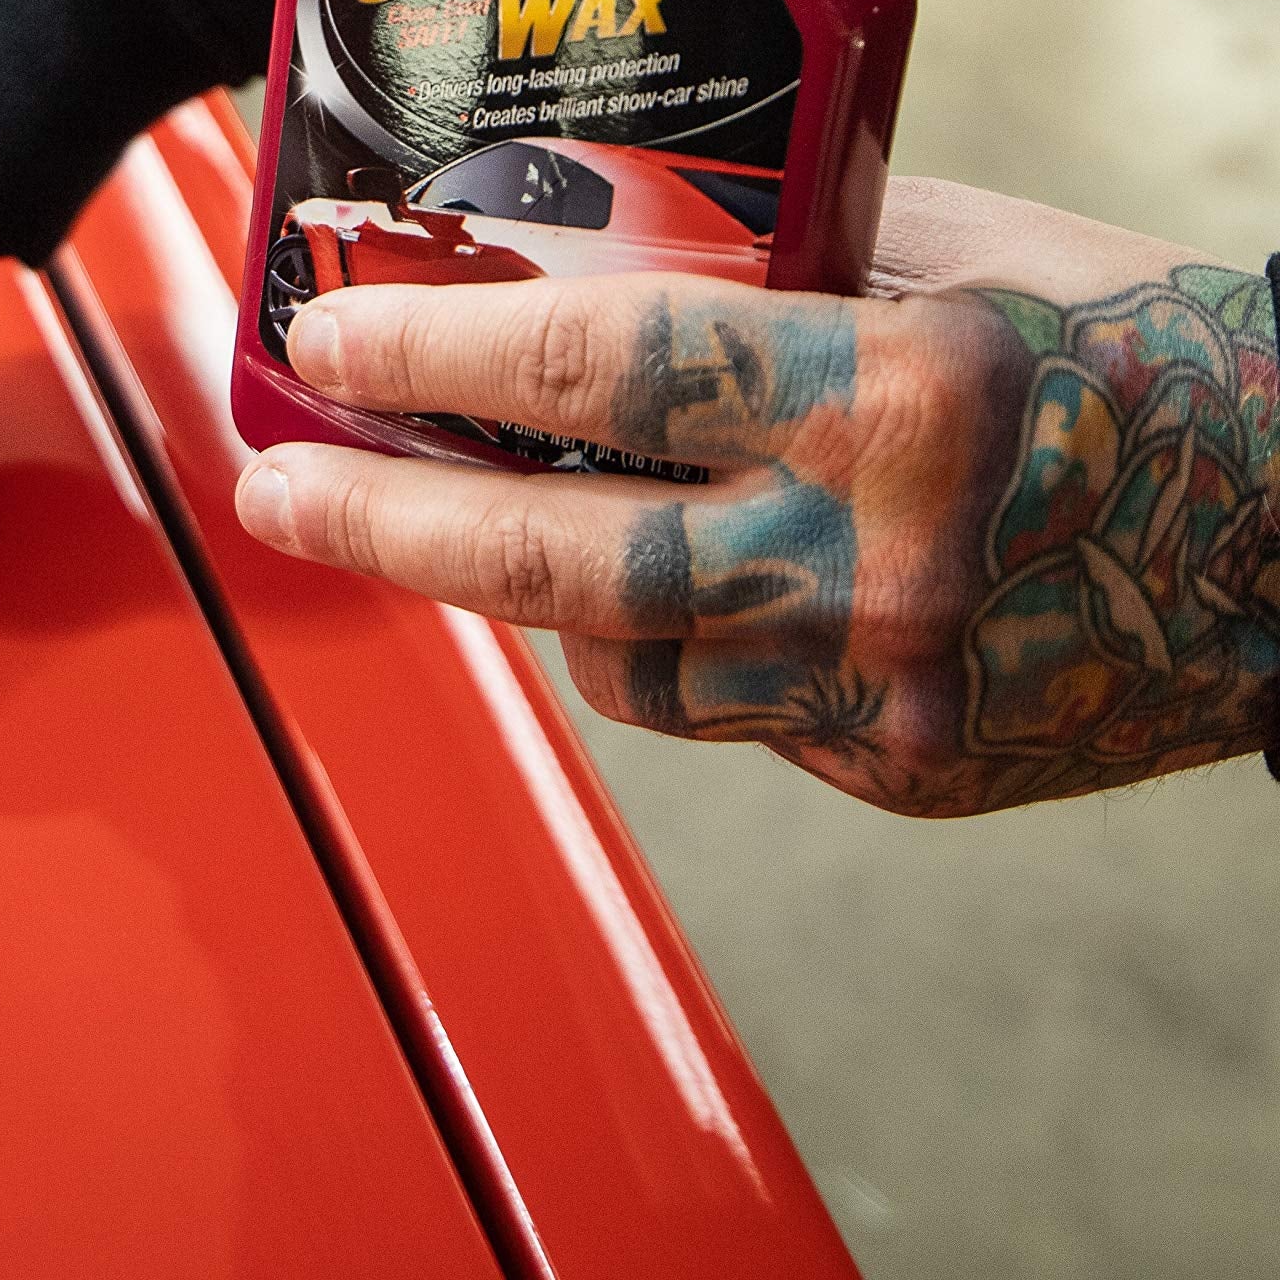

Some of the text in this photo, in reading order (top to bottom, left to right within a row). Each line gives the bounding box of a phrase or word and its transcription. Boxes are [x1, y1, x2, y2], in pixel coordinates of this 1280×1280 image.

[419, 51, 681, 101] Delivers long-lasting protection
[472, 75, 750, 129] Creates brilliant show-car shine
